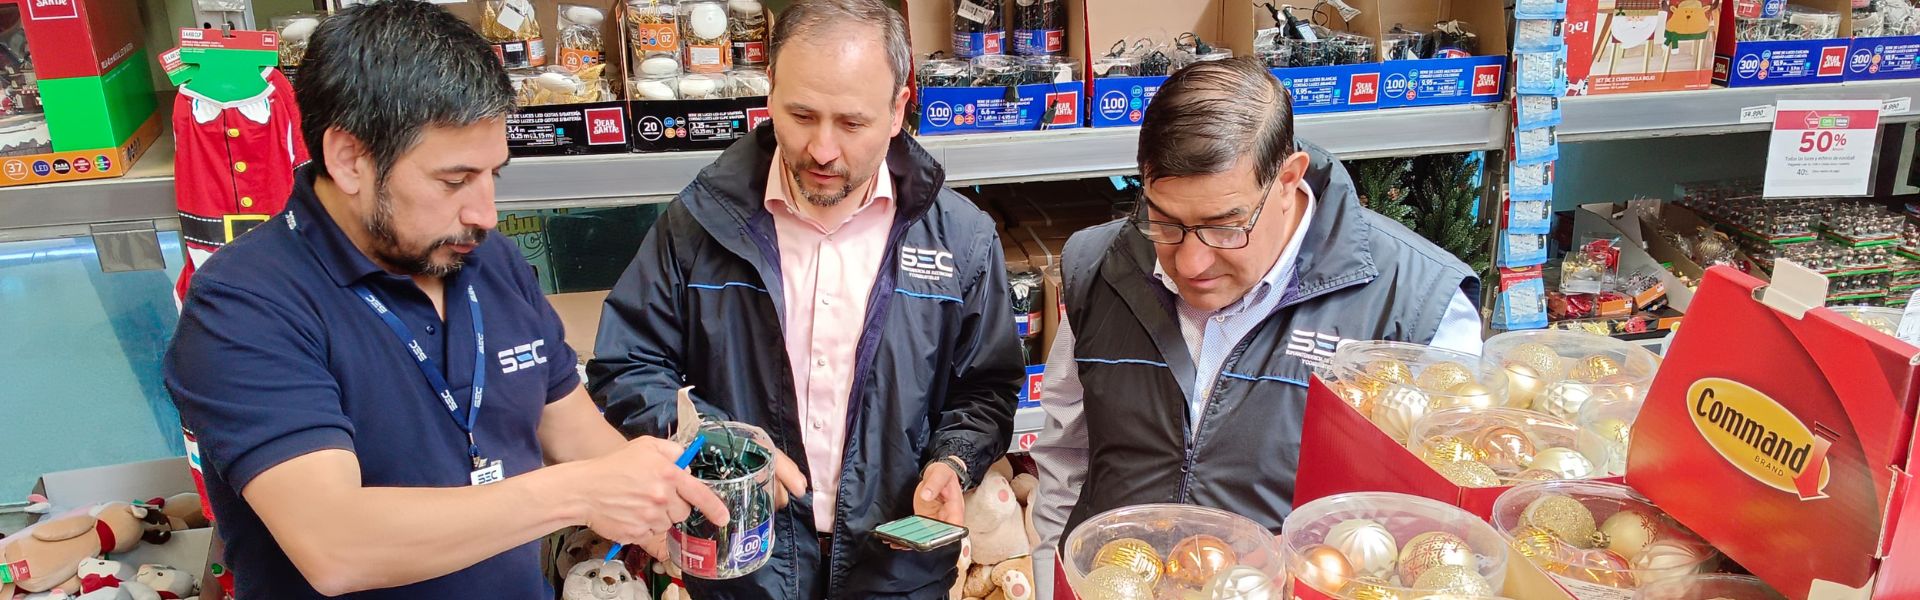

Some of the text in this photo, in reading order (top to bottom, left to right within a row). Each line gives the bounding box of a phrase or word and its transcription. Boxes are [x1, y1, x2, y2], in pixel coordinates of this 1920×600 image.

[567, 57, 576, 65] 20
[1740, 60, 1757, 69] 300
[1852, 55, 1869, 63] 300
[1386, 80, 1404, 89] 100
[1103, 98, 1124, 110] 100
[930, 107, 949, 117] 100
[594, 118, 615, 127] DEAR
[644, 122, 658, 132] 20
[592, 126, 619, 134] SANTA
[1799, 131, 1847, 152] 50%
[8, 164, 22, 172] 37
[901, 246, 953, 272] SEC
[365, 294, 388, 314] SEC
[408, 340, 428, 362] SEC
[498, 339, 548, 374] SEC
[440, 389, 458, 412] SEC
[474, 386, 482, 408] SEC
[1696, 387, 1812, 474] Command
[1754, 455, 1784, 477] BRAND
[478, 470, 498, 485] SEC
